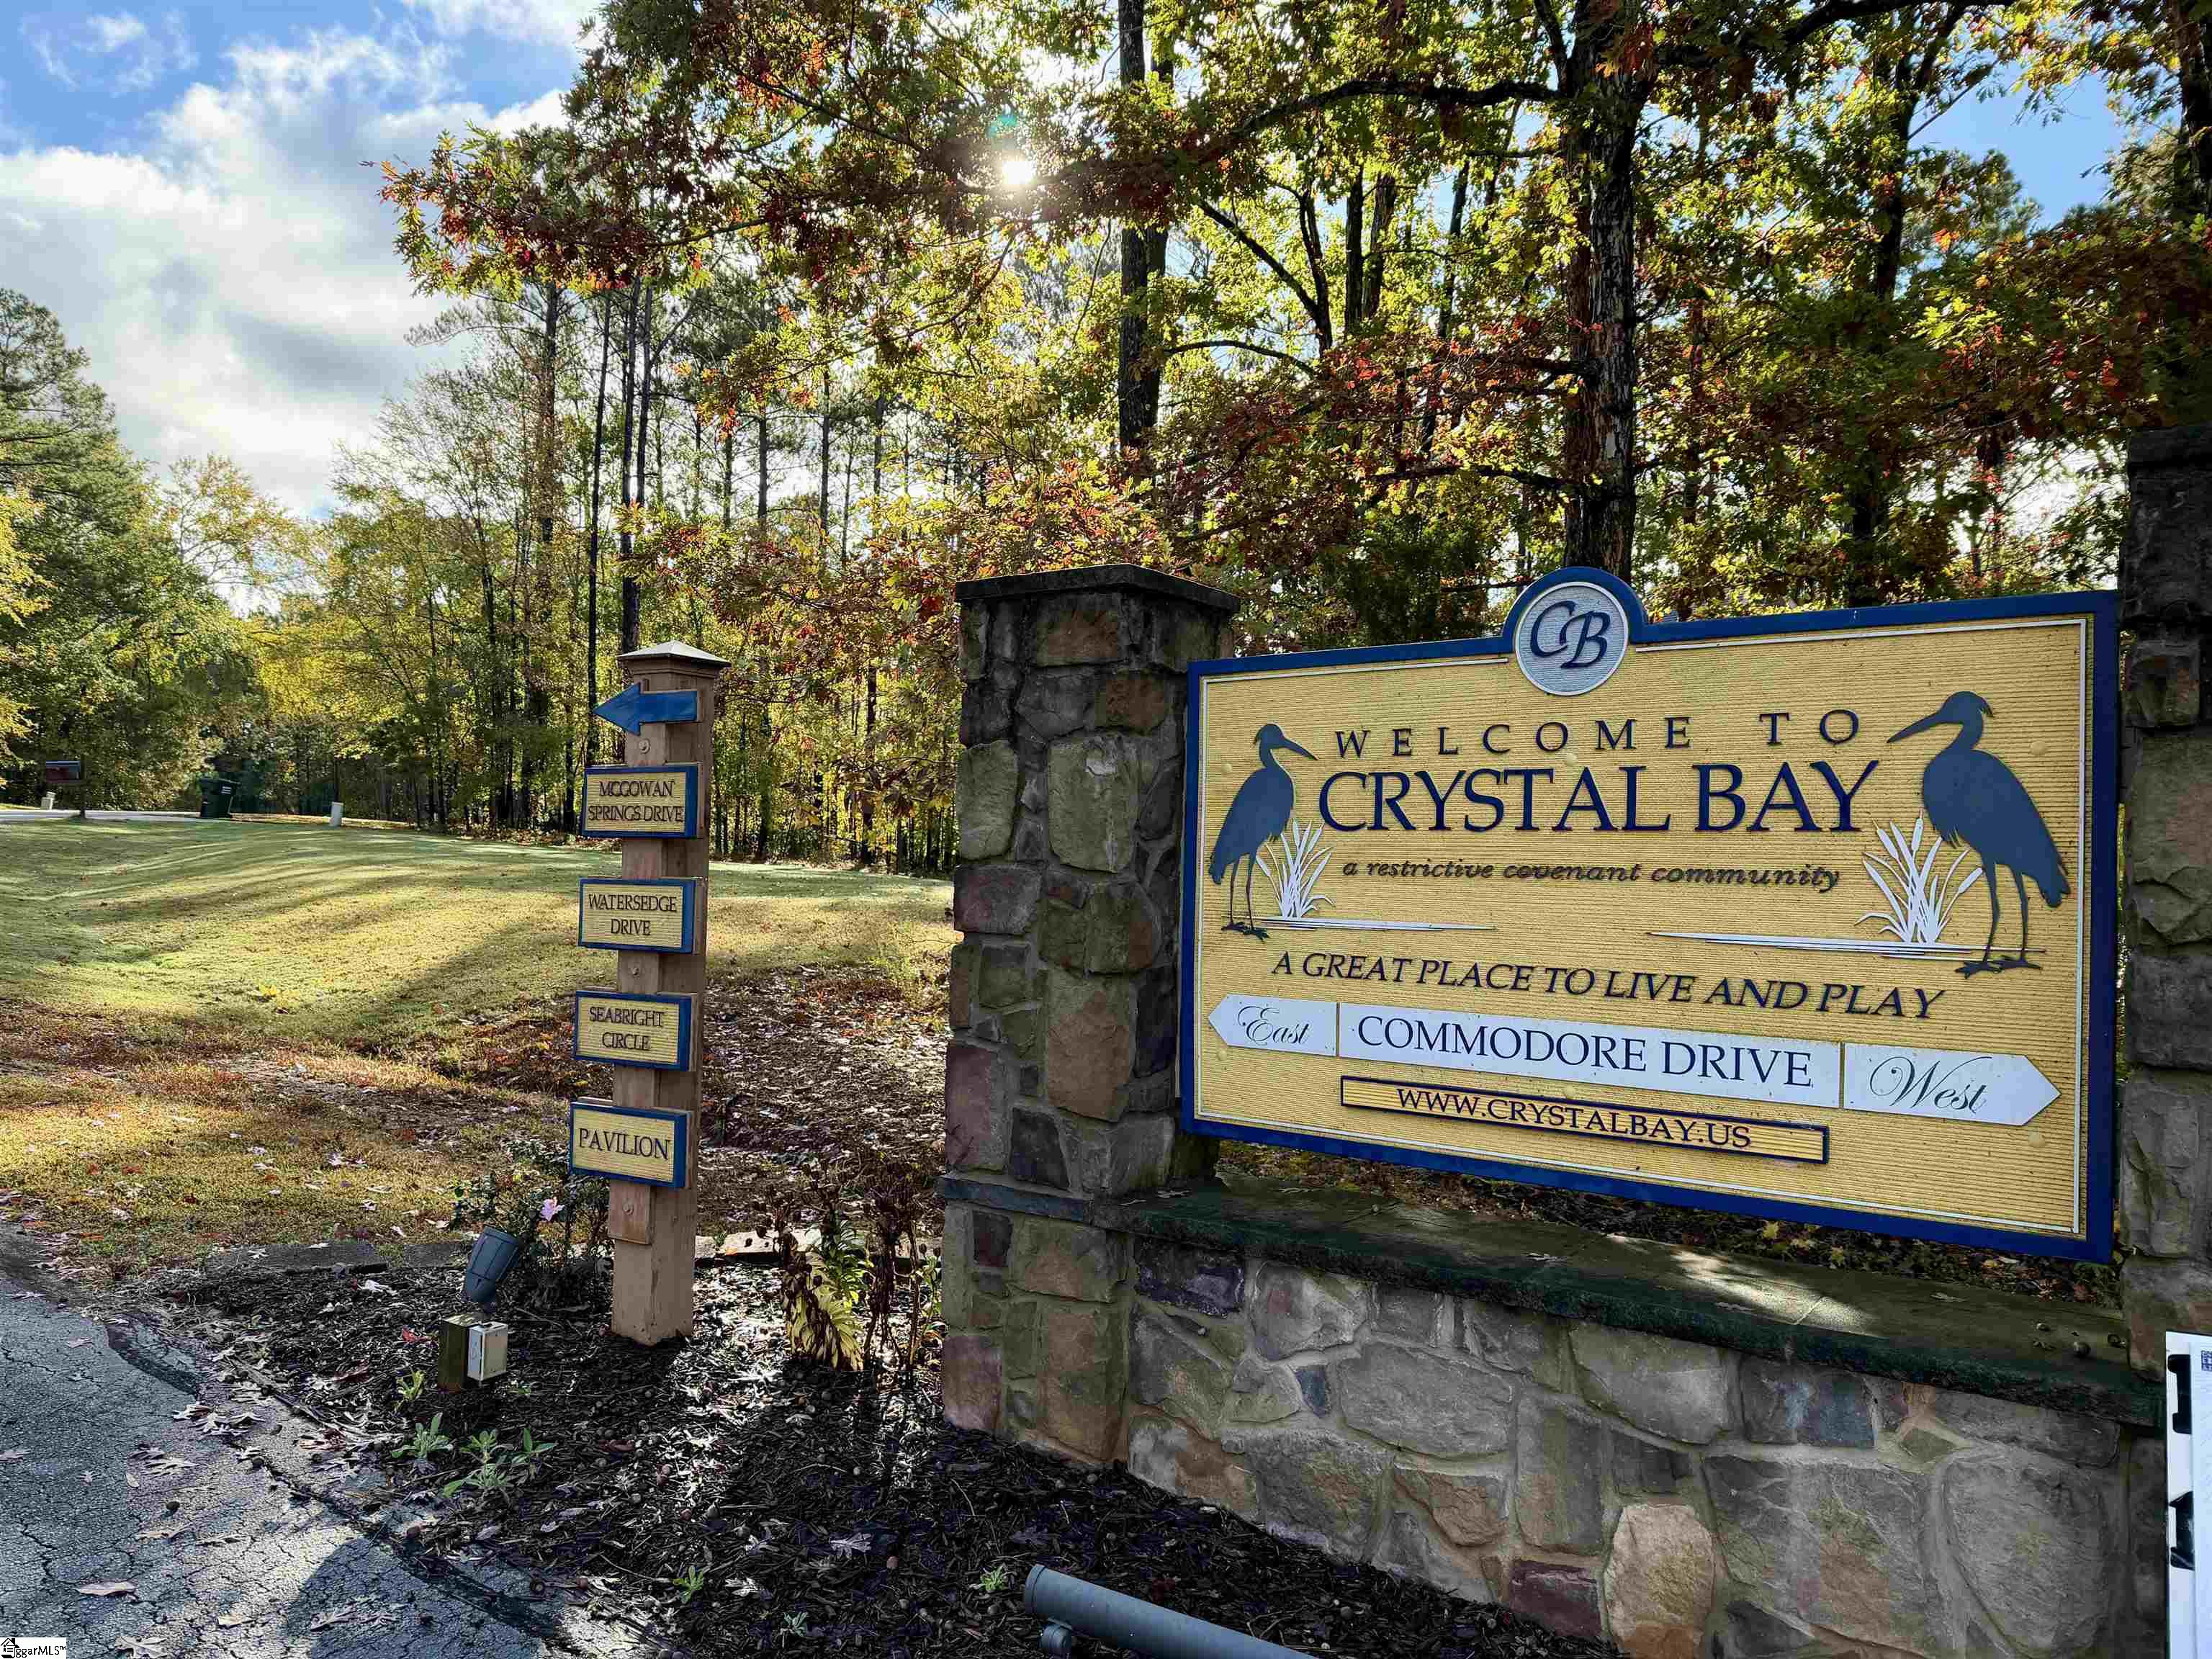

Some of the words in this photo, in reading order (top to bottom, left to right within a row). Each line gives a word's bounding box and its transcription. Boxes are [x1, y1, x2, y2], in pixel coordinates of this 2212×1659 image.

[1335, 716, 1691, 758] WELCOME
[1759, 709, 1861, 746] TO
[599, 781, 674, 797] MCGOWAN
[1318, 765, 1671, 833] CRYSTAL
[1692, 760, 1879, 833] BAY
[588, 805, 641, 822] SPRINGS
[643, 805, 684, 822] DRIVE
[1343, 861, 1358, 876] a
[1367, 857, 1493, 879] restrictive
[1503, 861, 1640, 881] covenant
[1650, 863, 1840, 894] community
[588, 894, 678, 912] WATERSEDGE
[611, 918, 652, 936] DRIVE
[1272, 950, 1294, 975] A
[1302, 953, 1413, 984] GREAT
[1416, 958, 1534, 993] PLACE
[1544, 966, 1596, 996] TO
[1604, 970, 1697, 1003] LIVE
[1703, 977, 1809, 1010] AND
[1815, 983, 1947, 1020] PLAY
[588, 1006, 664, 1028] SEABRIGHT
[1237, 1004, 1311, 1045] East
[601, 1032, 651, 1051] CIRCLE
[1358, 1015, 1647, 1071] COMMODORE
[1661, 1040, 1814, 1088] DRIVE
[1868, 1055, 1993, 1114] West
[1395, 1087, 1752, 1149] WWW.CRYSTALBAY.US
[578, 1128, 670, 1160] PAVILION
